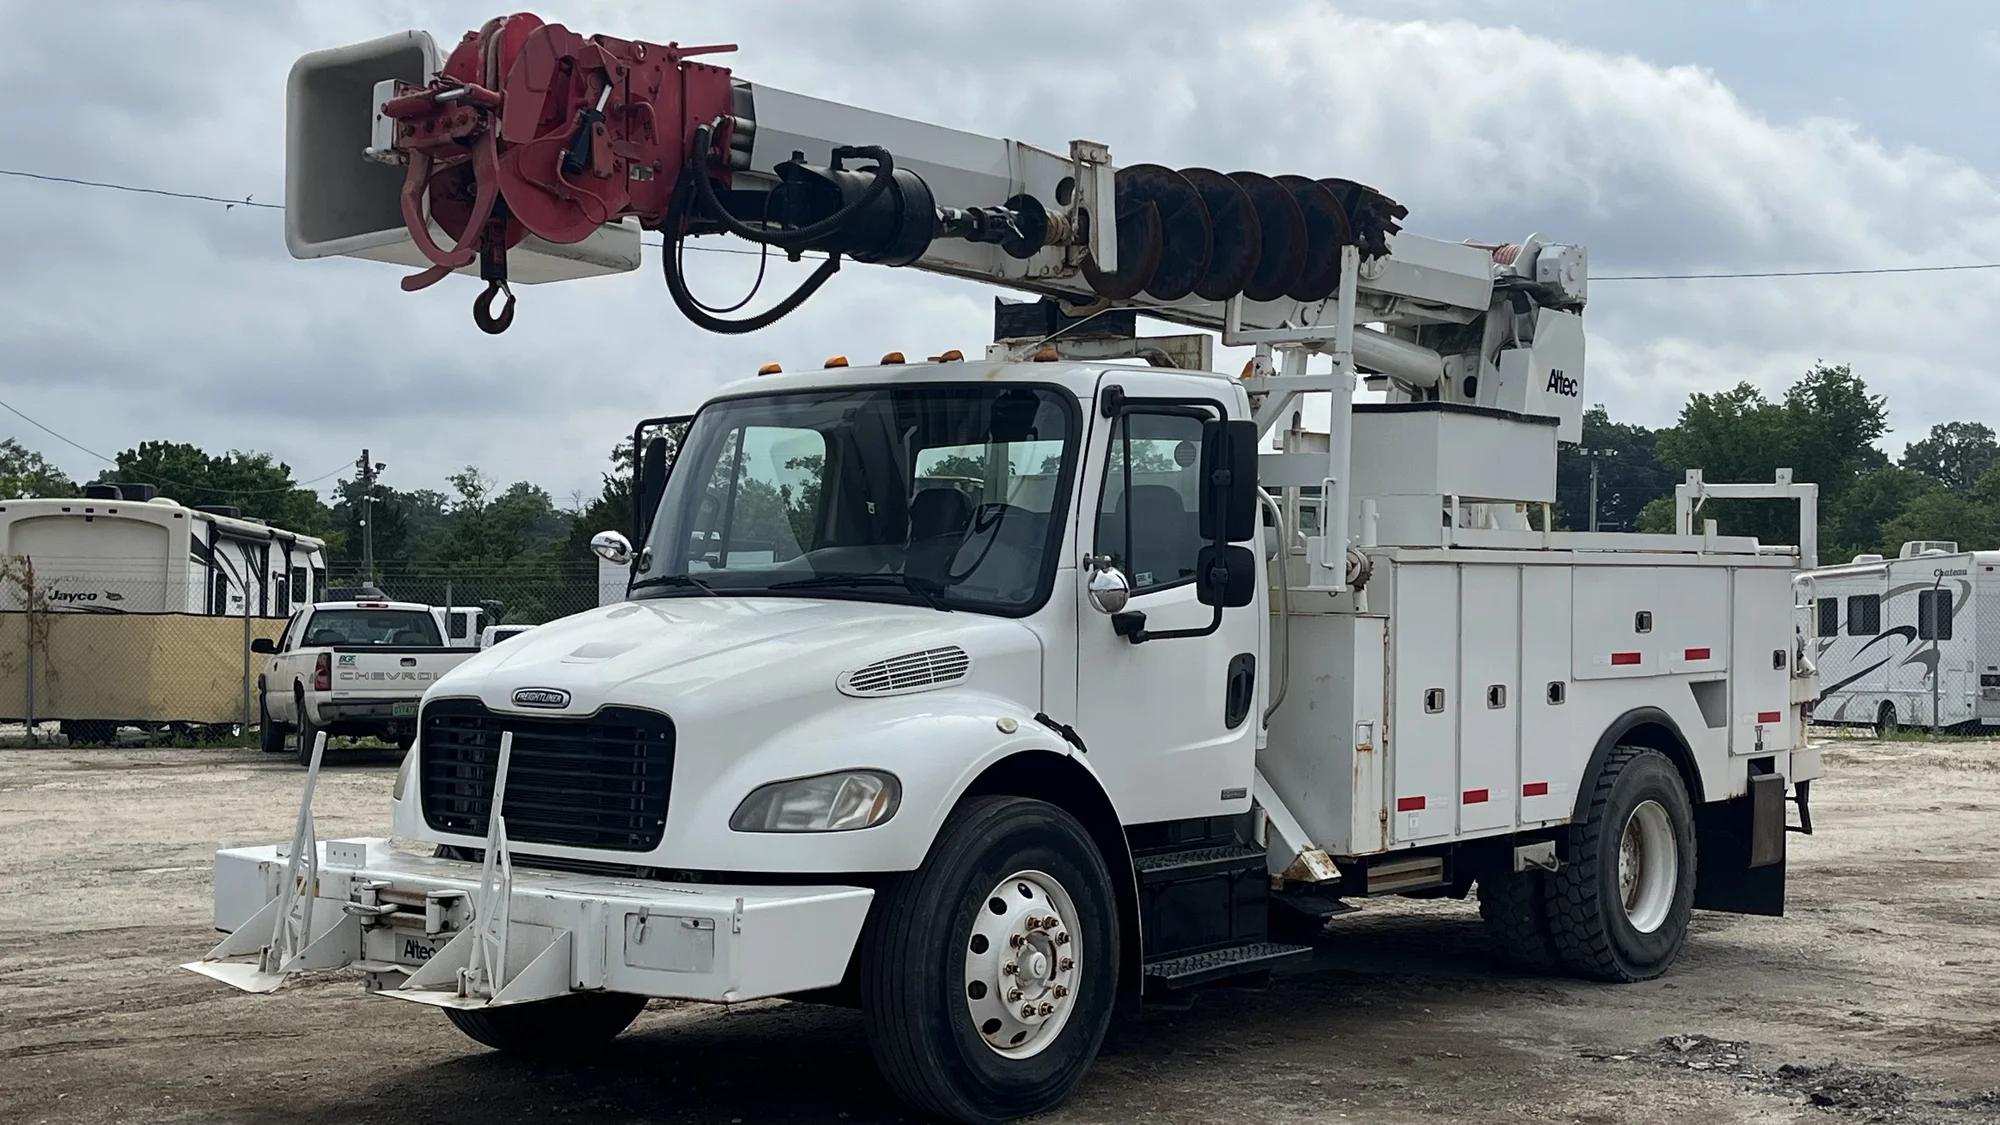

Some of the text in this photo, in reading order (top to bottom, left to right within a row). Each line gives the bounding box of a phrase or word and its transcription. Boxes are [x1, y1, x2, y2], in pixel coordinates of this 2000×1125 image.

[1546, 368, 1578, 397] Altec
[1933, 568, 1968, 577] Chateau
[48, 590, 97, 602] Jayco
[339, 655, 356, 663] BGE
[340, 671, 440, 680] CHEVROL
[516, 691, 562, 703] FREIGHTLINER
[403, 939, 437, 960] Altec
